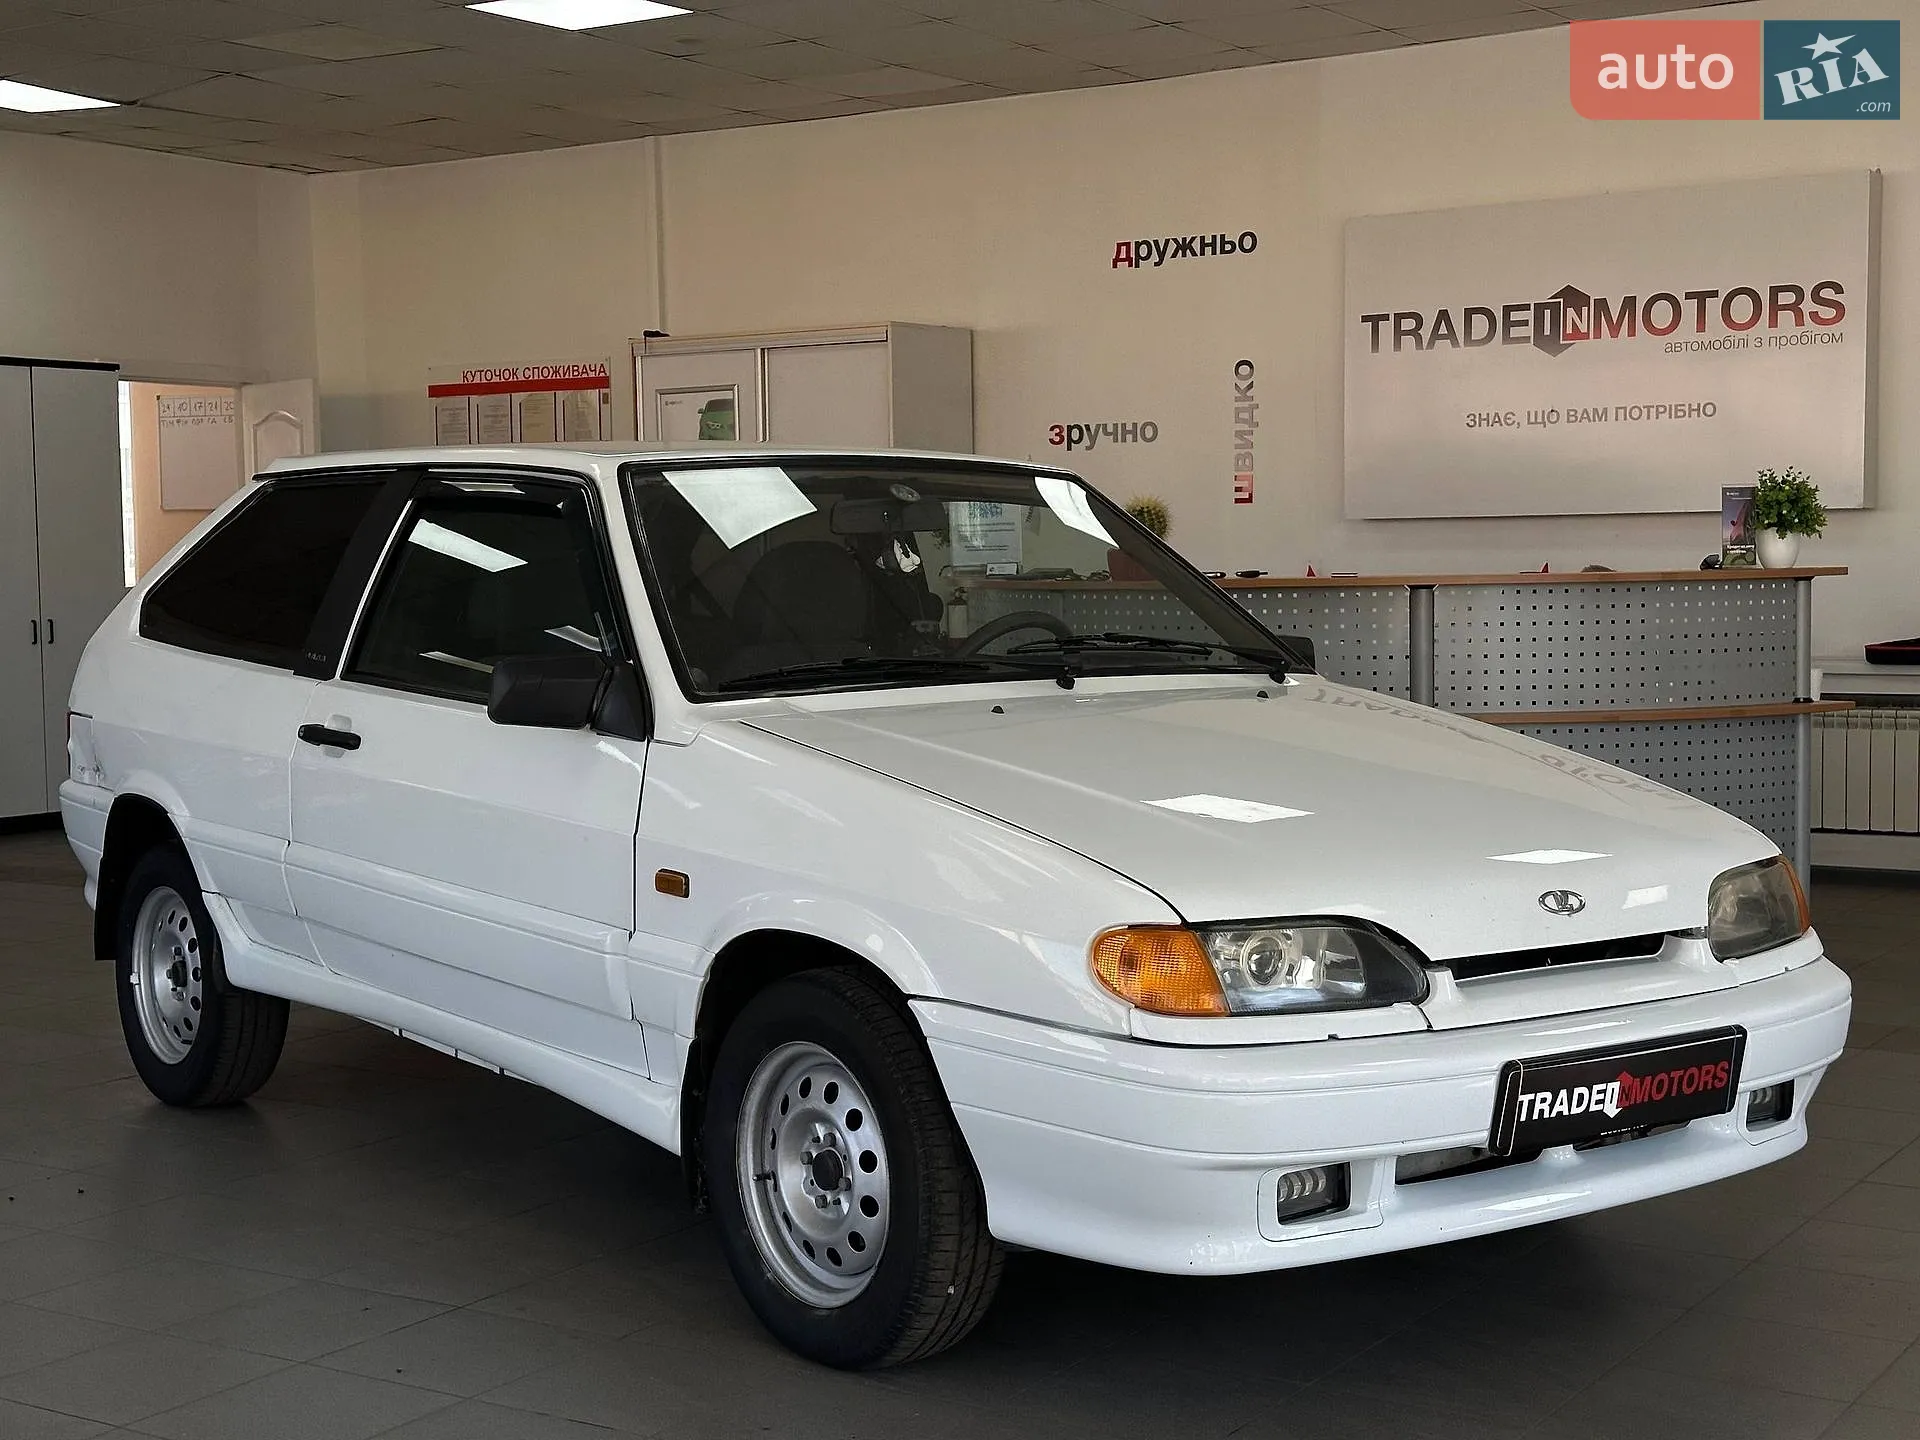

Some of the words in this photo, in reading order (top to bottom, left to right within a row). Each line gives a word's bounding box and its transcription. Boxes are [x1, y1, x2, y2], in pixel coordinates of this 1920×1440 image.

[1111, 230, 1258, 268] дружньо
[1664, 331, 1750, 354] автомобілі
[1753, 336, 1764, 347] з
[1767, 329, 1844, 352] пробігом
[462, 367, 519, 383] КУТОЧОК
[522, 363, 607, 379] СПОЖИВАЧА
[1465, 410, 1521, 430] ЗНАЄ,
[1526, 408, 1560, 427] ЩО
[1566, 406, 1608, 424] ВАМ
[1614, 401, 1717, 423] ПОТРІБНО
[1048, 420, 1158, 451] зручно
[1234, 358, 1259, 504] швидко
